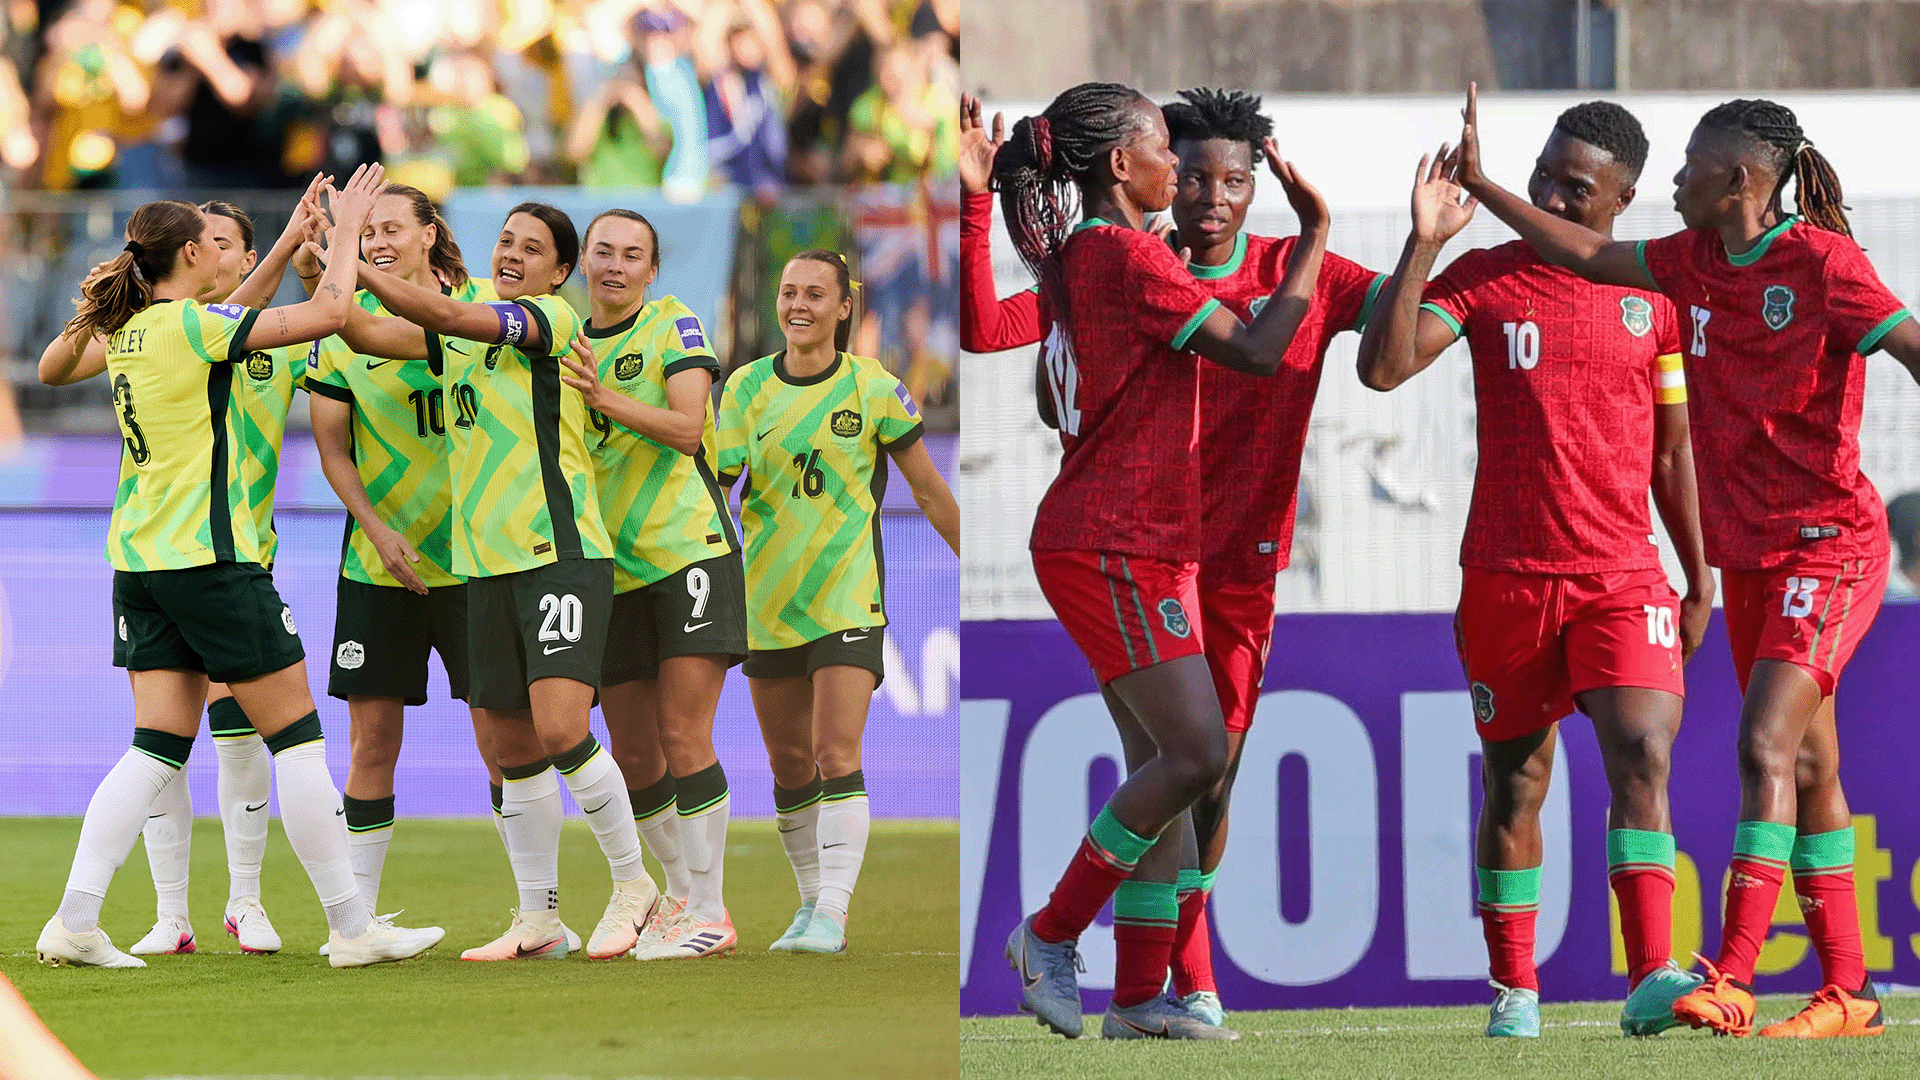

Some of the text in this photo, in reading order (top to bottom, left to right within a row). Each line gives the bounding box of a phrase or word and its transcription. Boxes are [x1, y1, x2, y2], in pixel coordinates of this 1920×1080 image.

[1503, 321, 1540, 370] 10
[1690, 305, 1712, 357] 13
[113, 373, 151, 467] 3
[408, 388, 446, 438] 10
[450, 382, 478, 430] 20
[589, 407, 613, 450] 9
[792, 448, 825, 499] 16
[538, 593, 583, 643] 20
[686, 567, 711, 619] 9
[1781, 576, 1820, 618] 13
[1643, 604, 1675, 648] 10
[960, 689, 1572, 992] OOD
